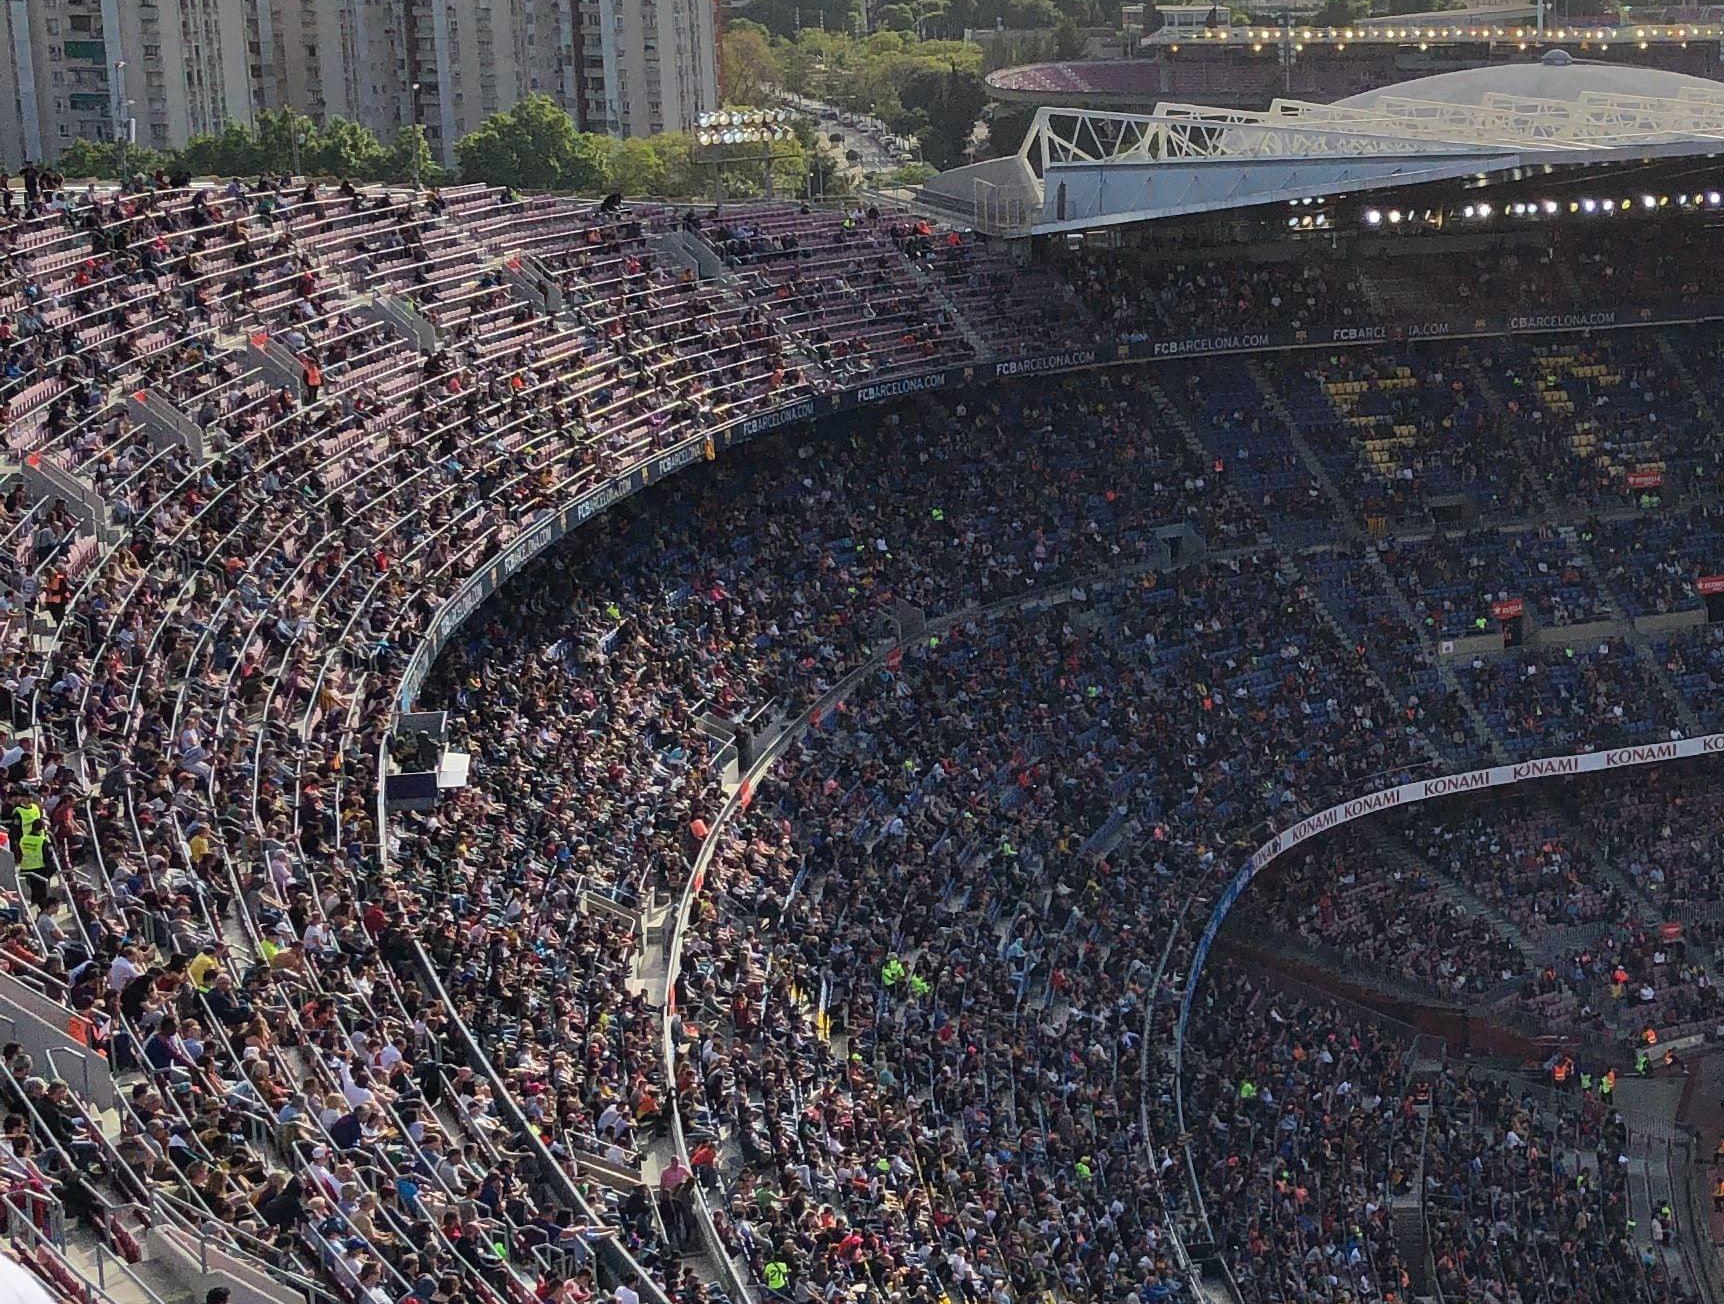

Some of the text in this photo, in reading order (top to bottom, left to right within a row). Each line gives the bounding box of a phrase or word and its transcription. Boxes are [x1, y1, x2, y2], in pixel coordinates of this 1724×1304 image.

[1511, 312, 1615, 329] CBARCELONA.COM
[1154, 335, 1269, 355] FCBARCELONA.COM
[997, 351, 1095, 376] FCBARCELONA.COM
[858, 375, 945, 402] FCBARCELONA.COM
[1606, 743, 1677, 766] KONAMI
[1424, 772, 1490, 796] KONAMI
[1344, 790, 1400, 819] KONAMI
